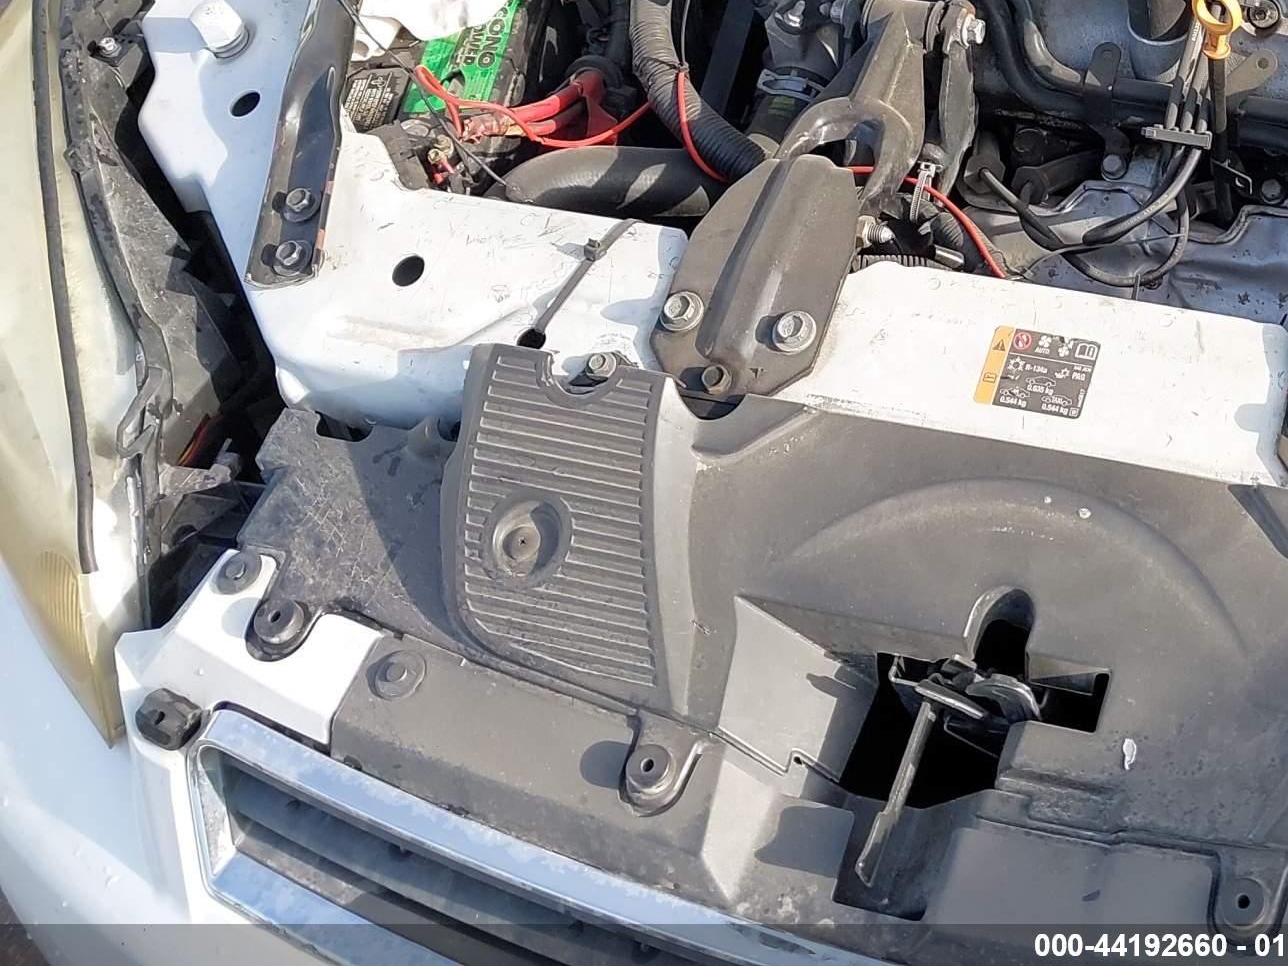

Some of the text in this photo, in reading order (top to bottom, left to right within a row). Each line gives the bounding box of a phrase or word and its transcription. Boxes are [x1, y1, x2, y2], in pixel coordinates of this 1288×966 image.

[1045, 387, 1054, 395] kg
[1018, 399, 1027, 407] kg
[1059, 407, 1068, 415] kg
